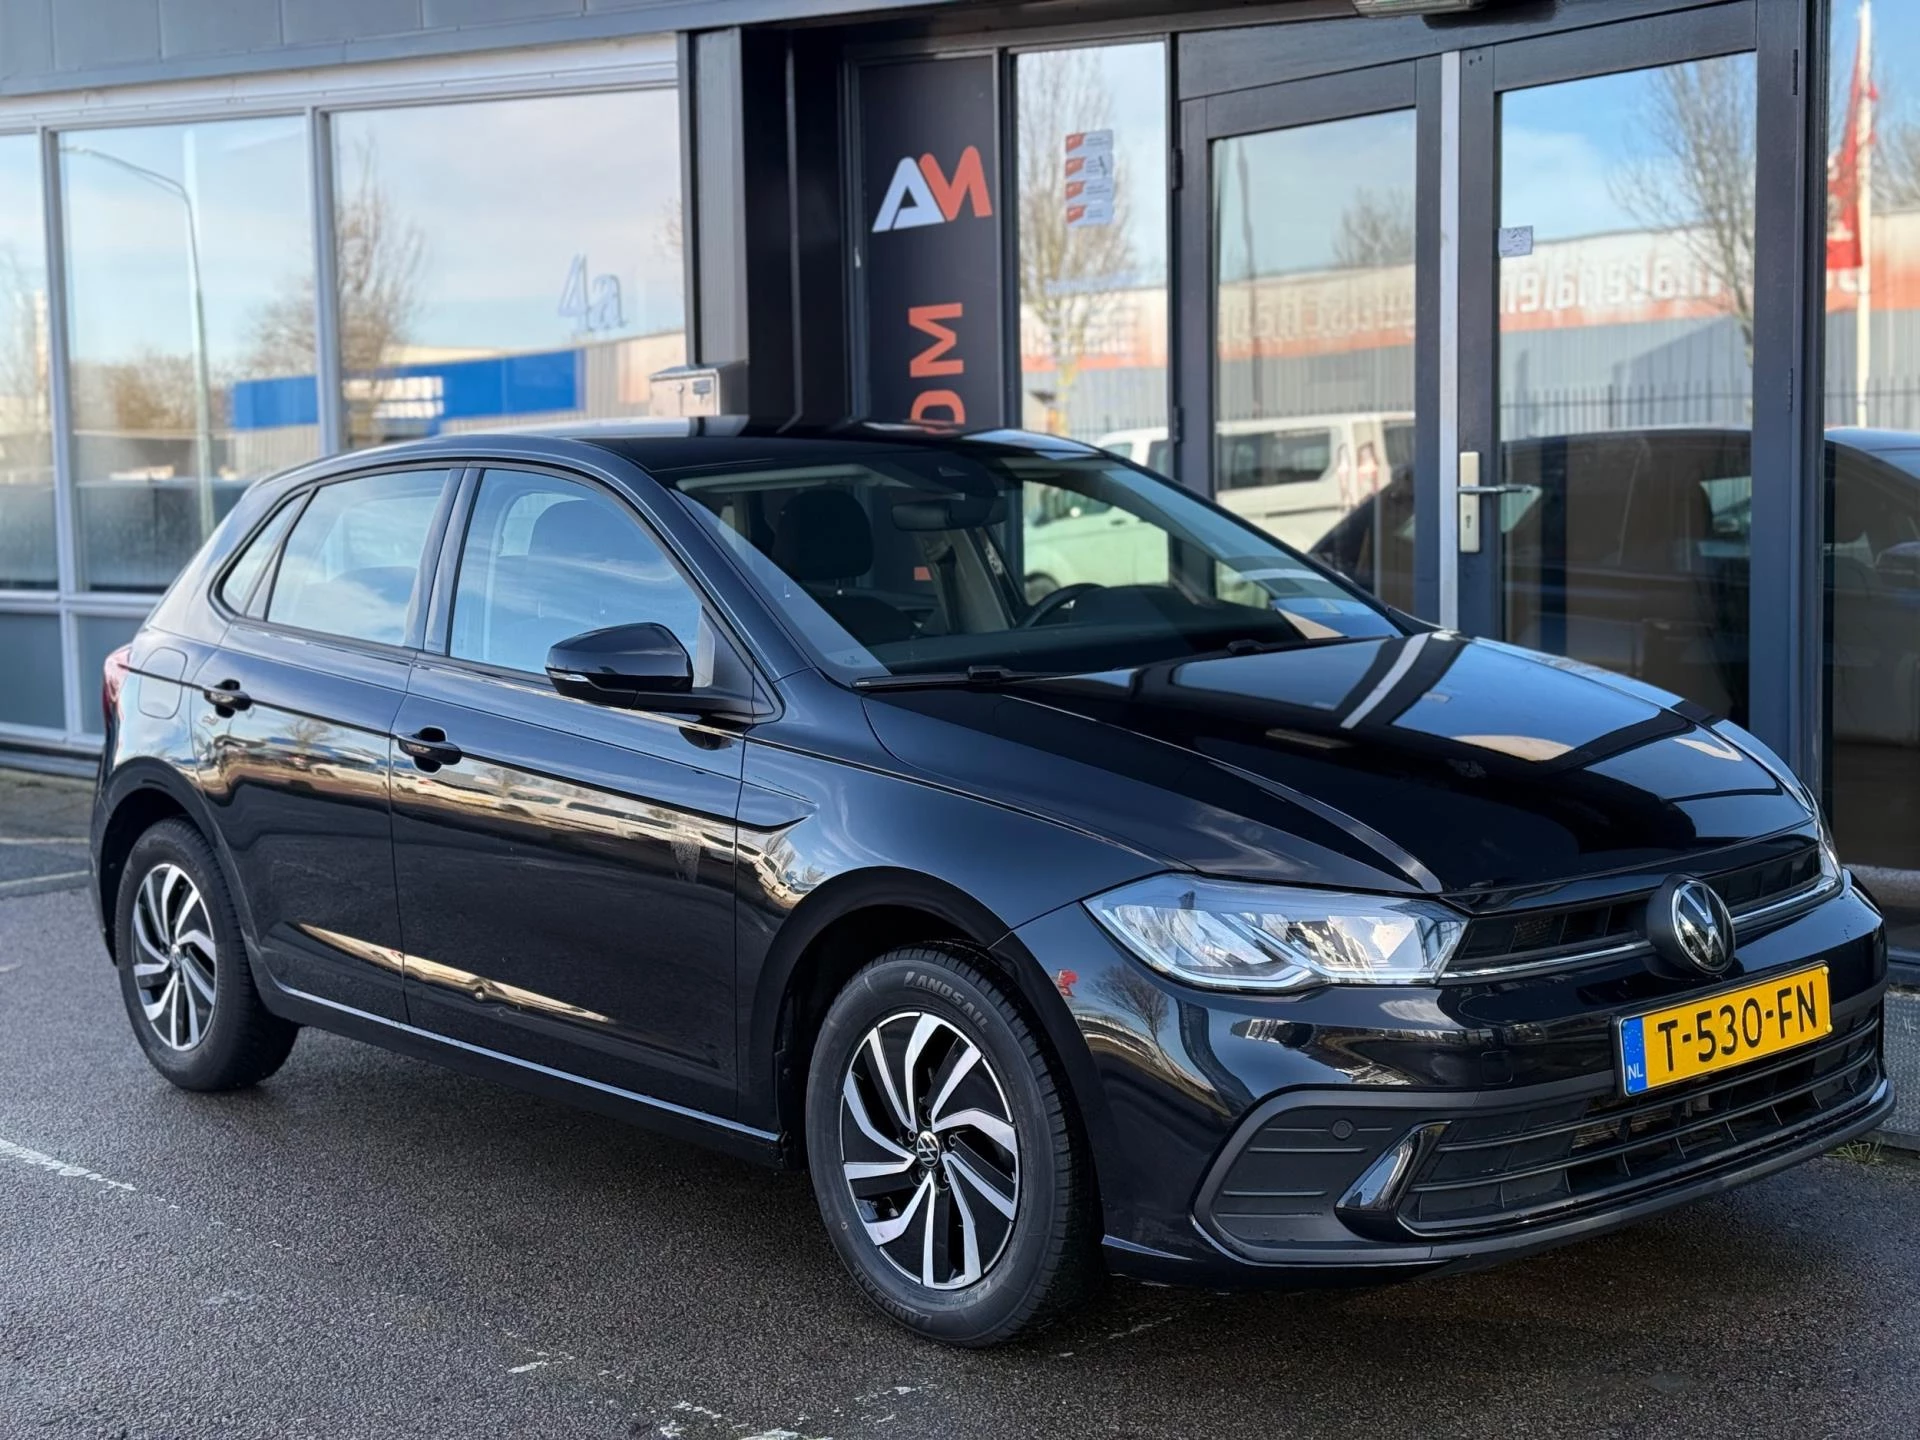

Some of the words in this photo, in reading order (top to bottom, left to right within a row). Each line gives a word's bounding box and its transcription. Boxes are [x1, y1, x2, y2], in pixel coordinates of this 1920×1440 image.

[871, 145, 993, 233] AM
[1656, 980, 1817, 1073] T-530-FN
[1627, 1061, 1644, 1081] NL
